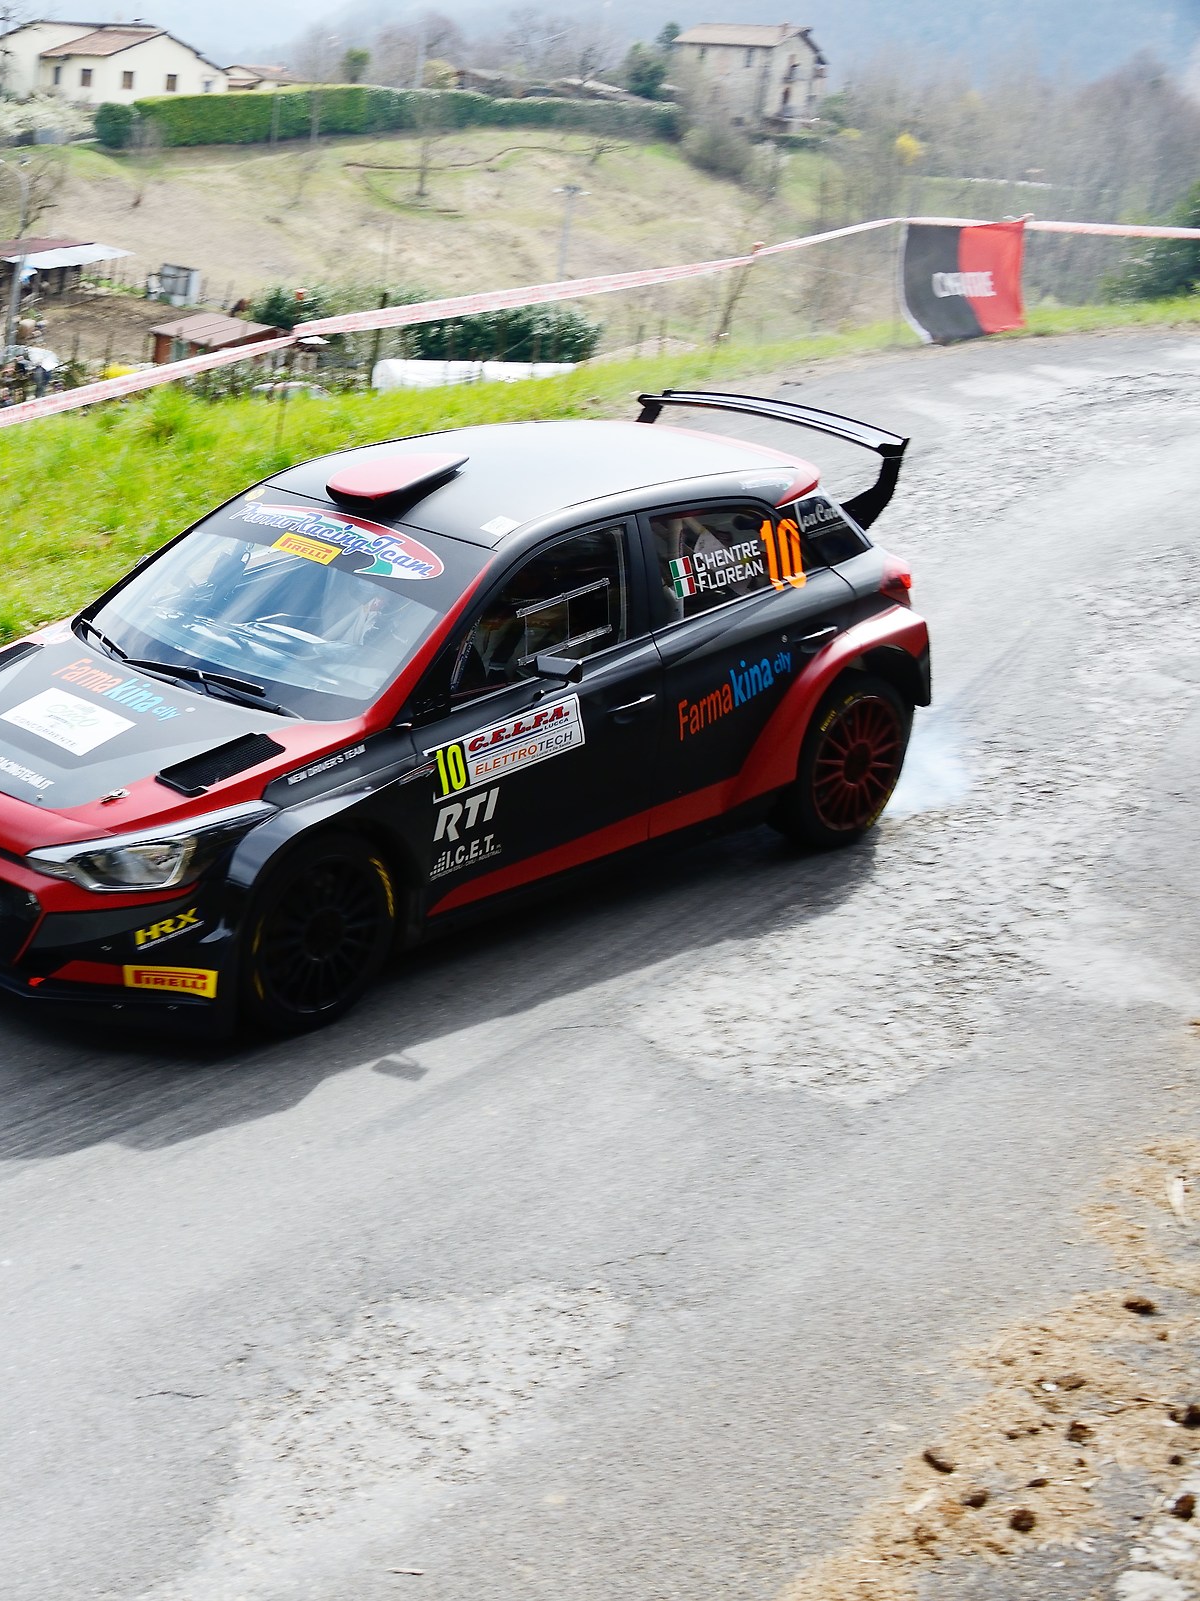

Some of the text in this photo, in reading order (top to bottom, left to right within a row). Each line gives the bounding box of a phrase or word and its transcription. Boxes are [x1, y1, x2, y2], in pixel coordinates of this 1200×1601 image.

[280, 537, 333, 560] PIRELLI
[692, 540, 761, 573] CHENTRE
[760, 518, 807, 591] 10
[697, 559, 764, 592] FLOREAN
[678, 658, 775, 741] Farmakina
[544, 718, 569, 730] LUCCA
[287, 771, 308, 786] NEW
[343, 744, 367, 761] TEAM
[435, 744, 467, 795] 10
[475, 730, 573, 776] ELETTROTECH
[433, 786, 500, 842] RTI
[134, 907, 200, 946] HRX
[132, 969, 208, 991] PIRELLI
